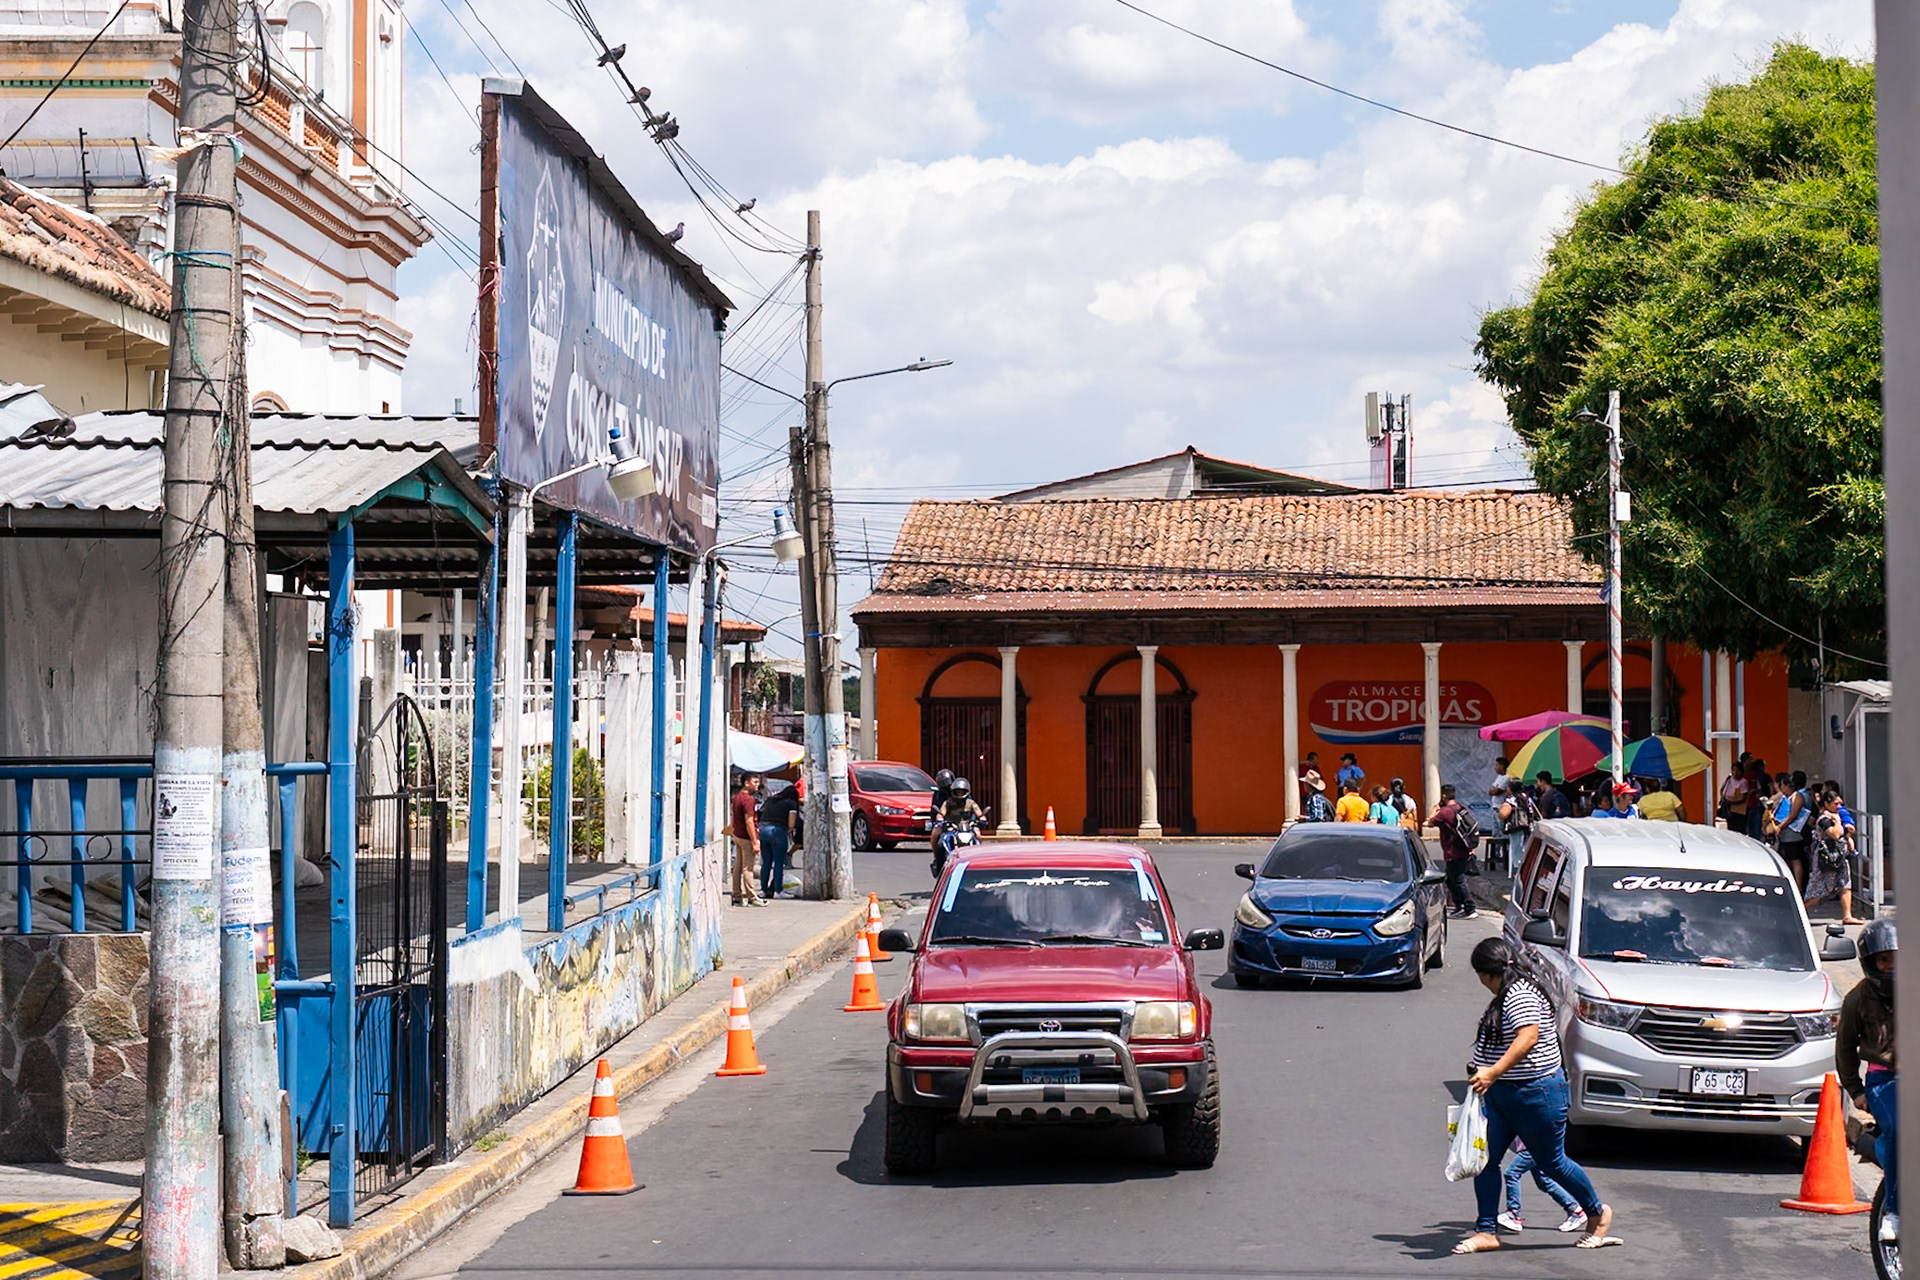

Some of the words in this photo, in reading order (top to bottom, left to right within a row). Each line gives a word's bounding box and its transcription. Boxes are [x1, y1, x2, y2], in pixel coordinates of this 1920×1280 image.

[595, 271, 650, 370] MUNICIPIO
[651, 321, 667, 380] DE
[655, 425, 683, 502] SUR
[1348, 685, 1457, 697] ALMACEES
[224, 856, 262, 867] Fudem
[1694, 1072, 1700, 1087] P
[1704, 1073, 1718, 1088] 65
[1725, 1074, 1744, 1089] C23
